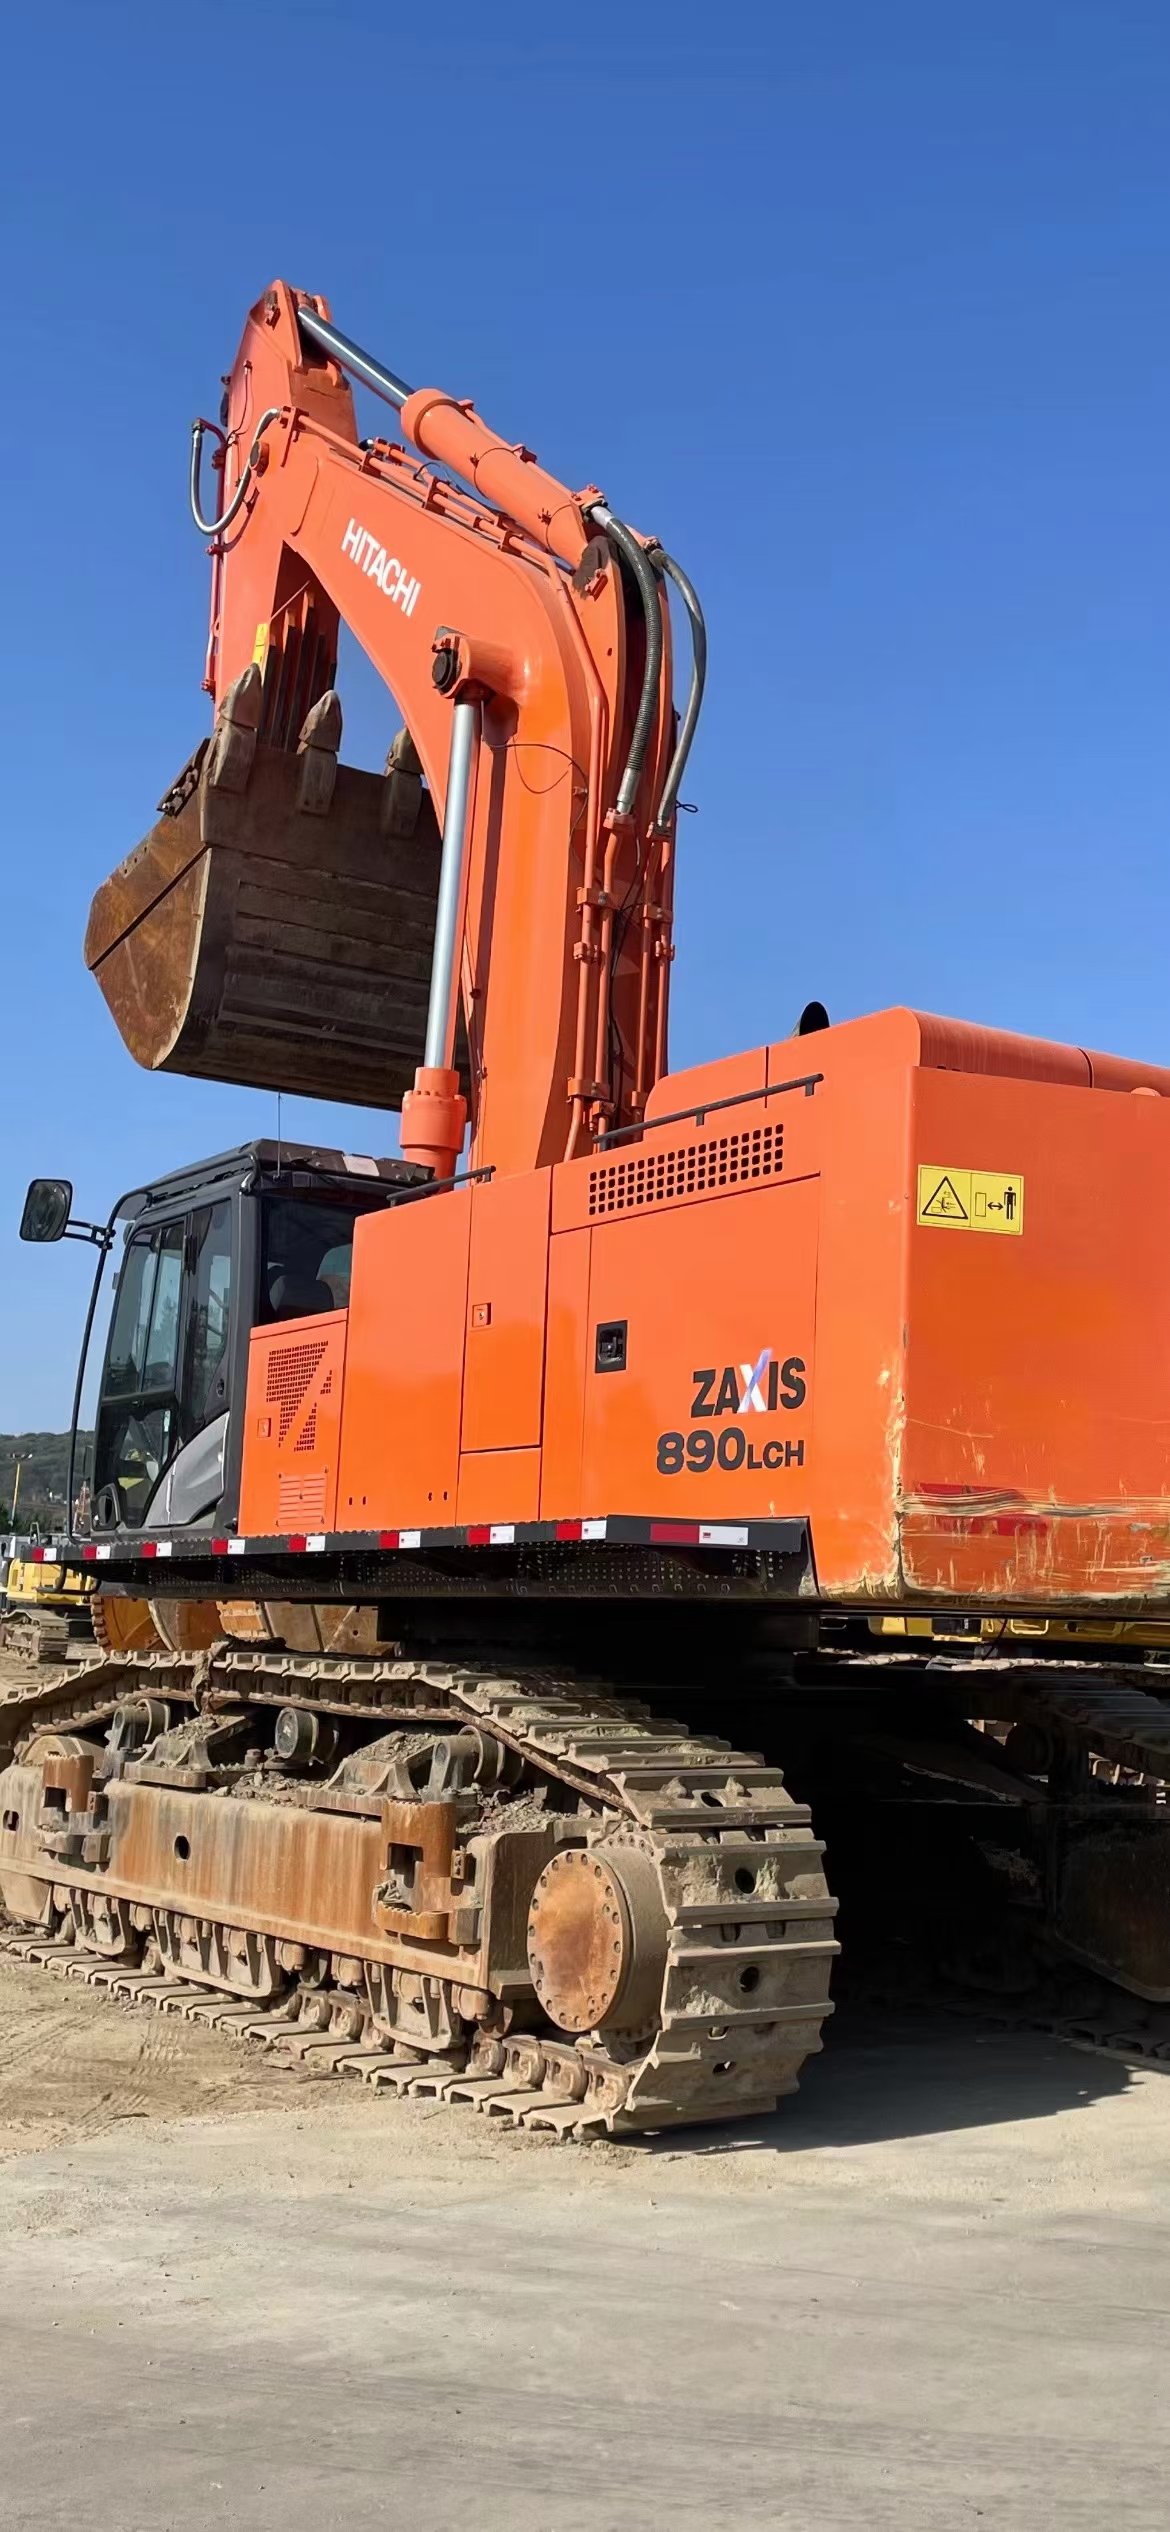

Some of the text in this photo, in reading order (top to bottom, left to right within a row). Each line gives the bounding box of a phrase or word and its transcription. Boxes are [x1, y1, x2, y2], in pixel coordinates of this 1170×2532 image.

[341, 517, 421, 617] HITACHI
[690, 1349, 806, 1418] ZAXIS
[656, 1427, 805, 1475] 890LCH
